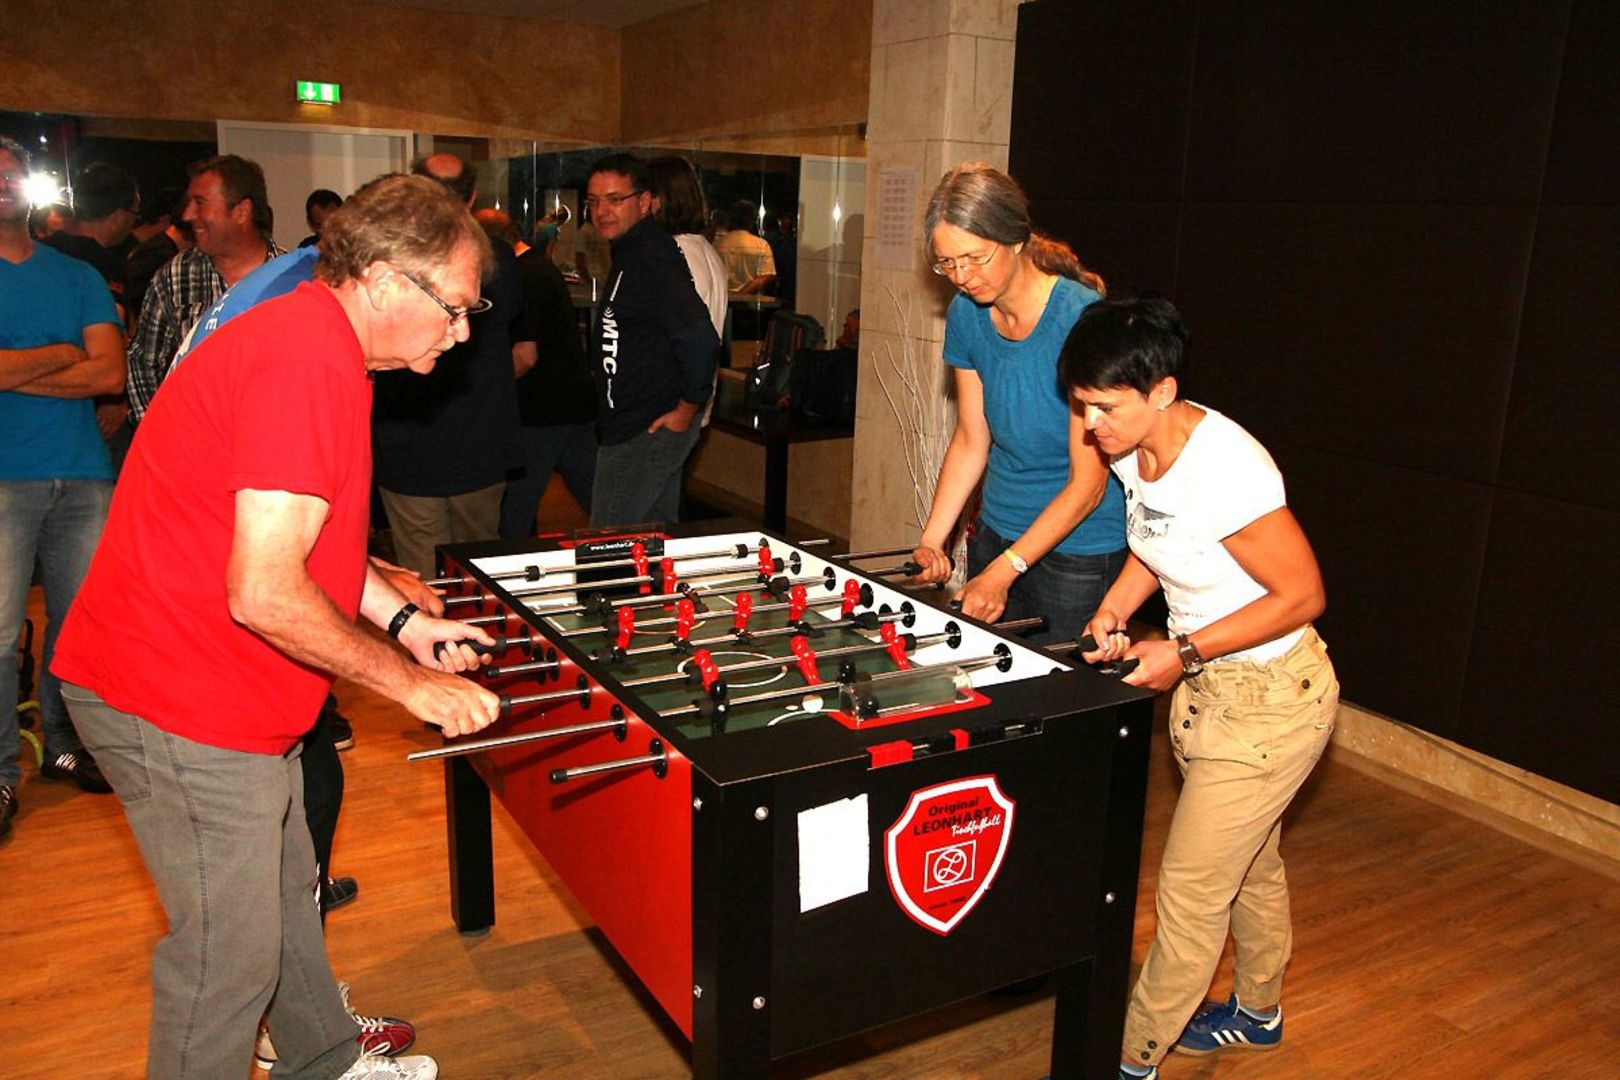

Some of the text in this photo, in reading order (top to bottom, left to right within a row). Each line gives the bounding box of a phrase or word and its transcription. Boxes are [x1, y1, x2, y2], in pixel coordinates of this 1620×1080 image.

[602, 317, 619, 375] MTC
[913, 806, 992, 836] LEONHART
[928, 797, 979, 817] Original
